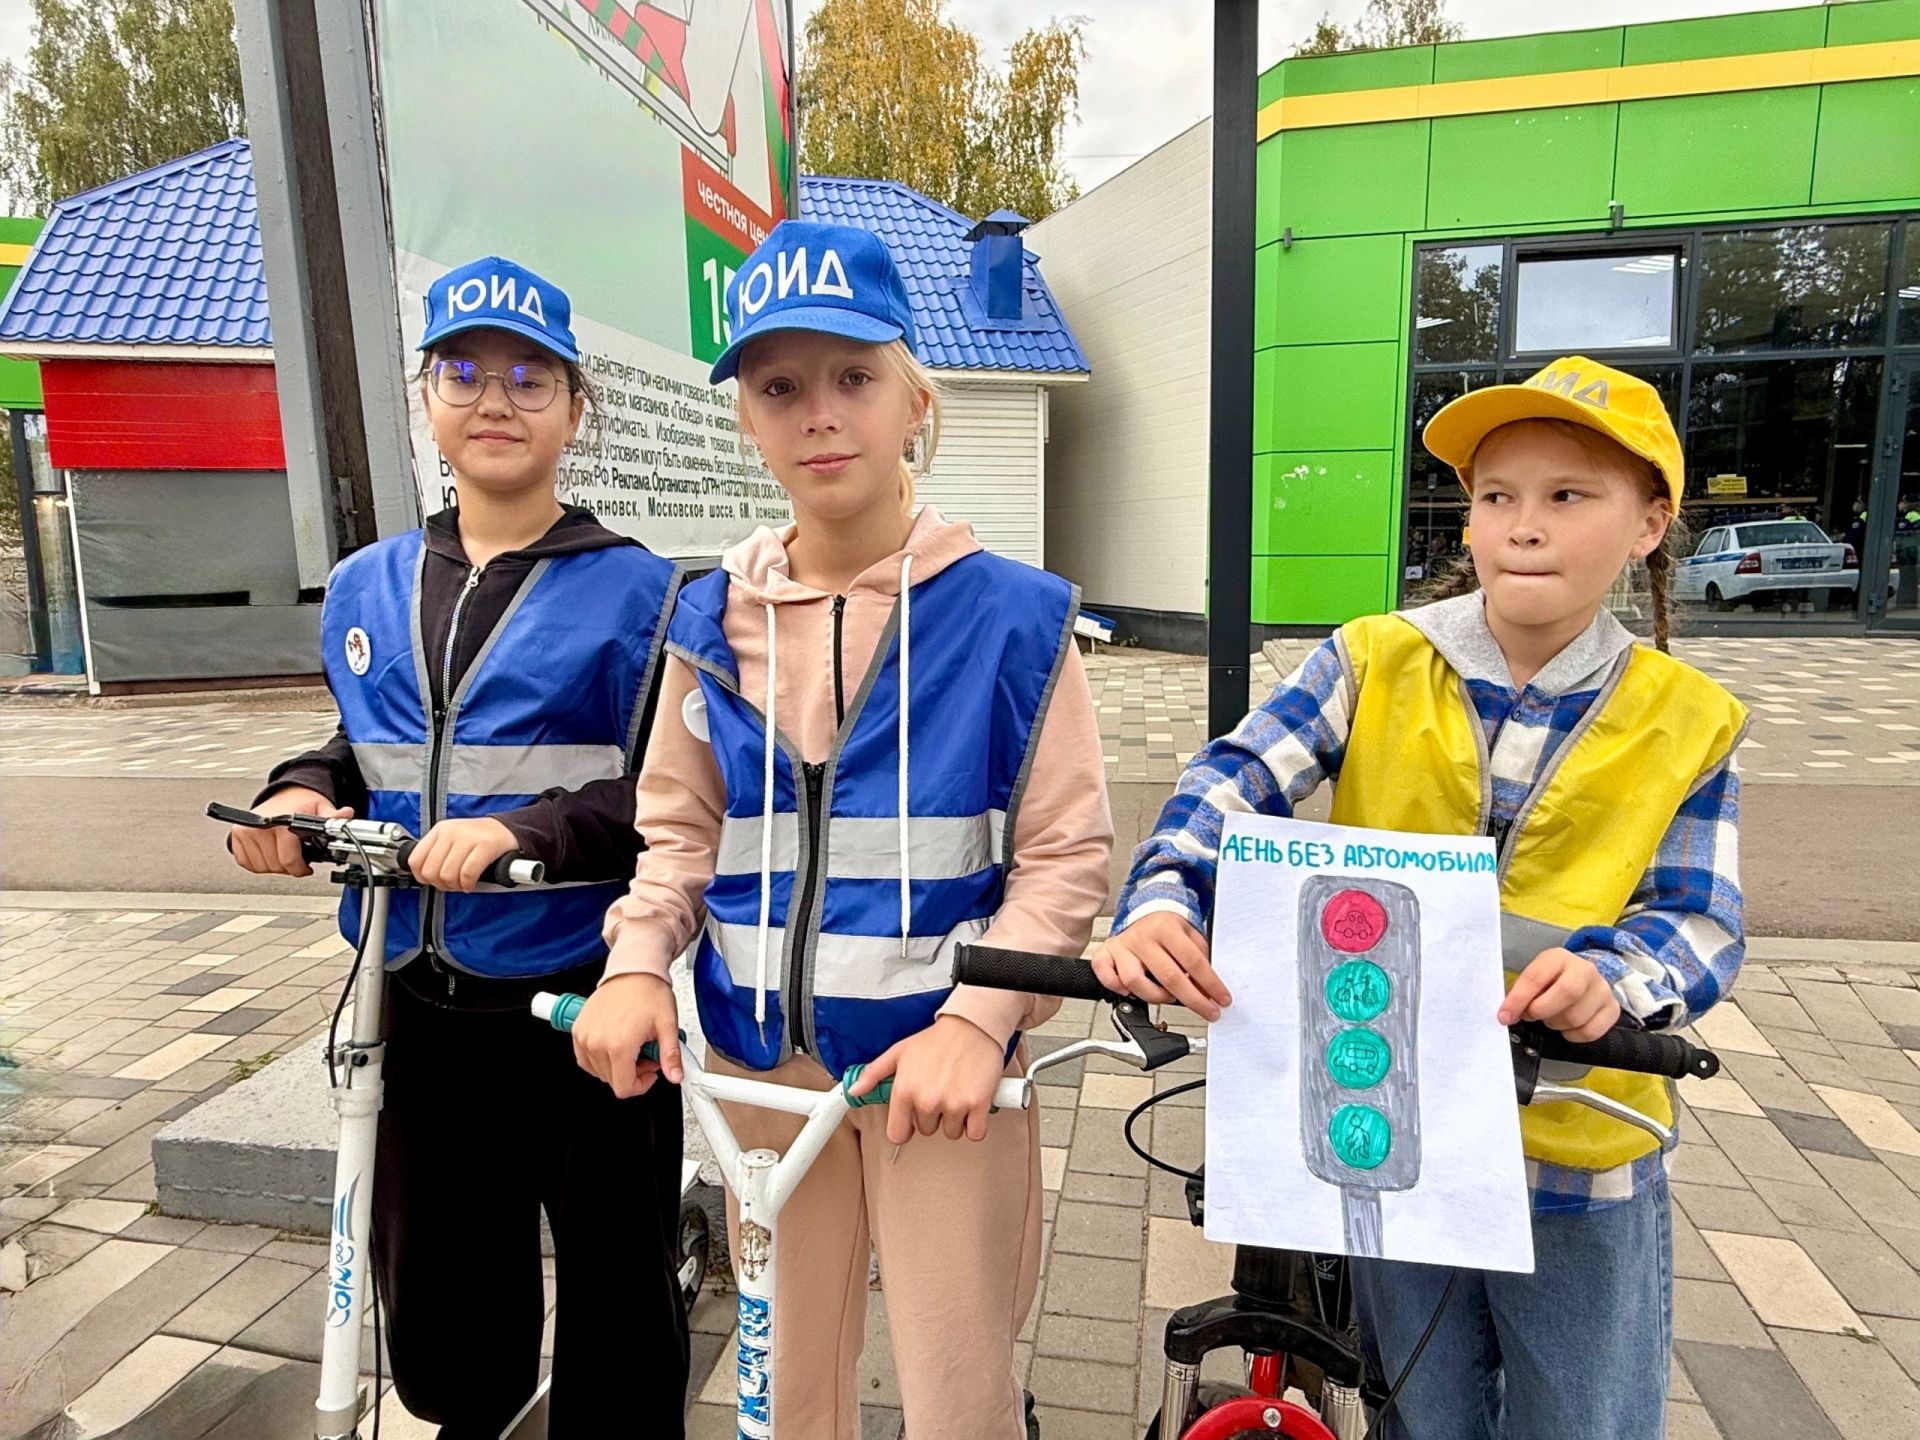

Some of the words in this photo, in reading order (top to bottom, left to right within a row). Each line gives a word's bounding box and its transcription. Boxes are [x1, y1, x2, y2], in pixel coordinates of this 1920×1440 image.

[697, 179, 748, 235] честная
[447, 274, 547, 327] ЮИД
[739, 247, 853, 329] ЮИД
[592, 353, 637, 386] действует
[637, 369, 651, 391] при
[651, 374, 683, 397] наличии
[683, 383, 705, 406] товара
[1530, 371, 1609, 411] ИД
[606, 387, 627, 409] всех
[629, 393, 670, 418] магазинов
[671, 400, 704, 427] «Победа»
[705, 414, 714, 428] на
[603, 438, 640, 463] Условия
[640, 449, 662, 471] могут
[662, 447, 681, 469] быть
[714, 455, 725, 474] без
[655, 420, 706, 449] Изображение
[709, 437, 735, 457] товаров
[558, 462, 594, 492] рублях
[702, 476, 720, 496] ОГРН
[648, 496, 704, 518] Московское
[709, 504, 736, 521] шоссе,
[1222, 833, 1283, 864] ДЕНЬ
[1288, 840, 1335, 868] БЕЗ
[1343, 845, 1497, 874] АВТОМОБИЛЯ
